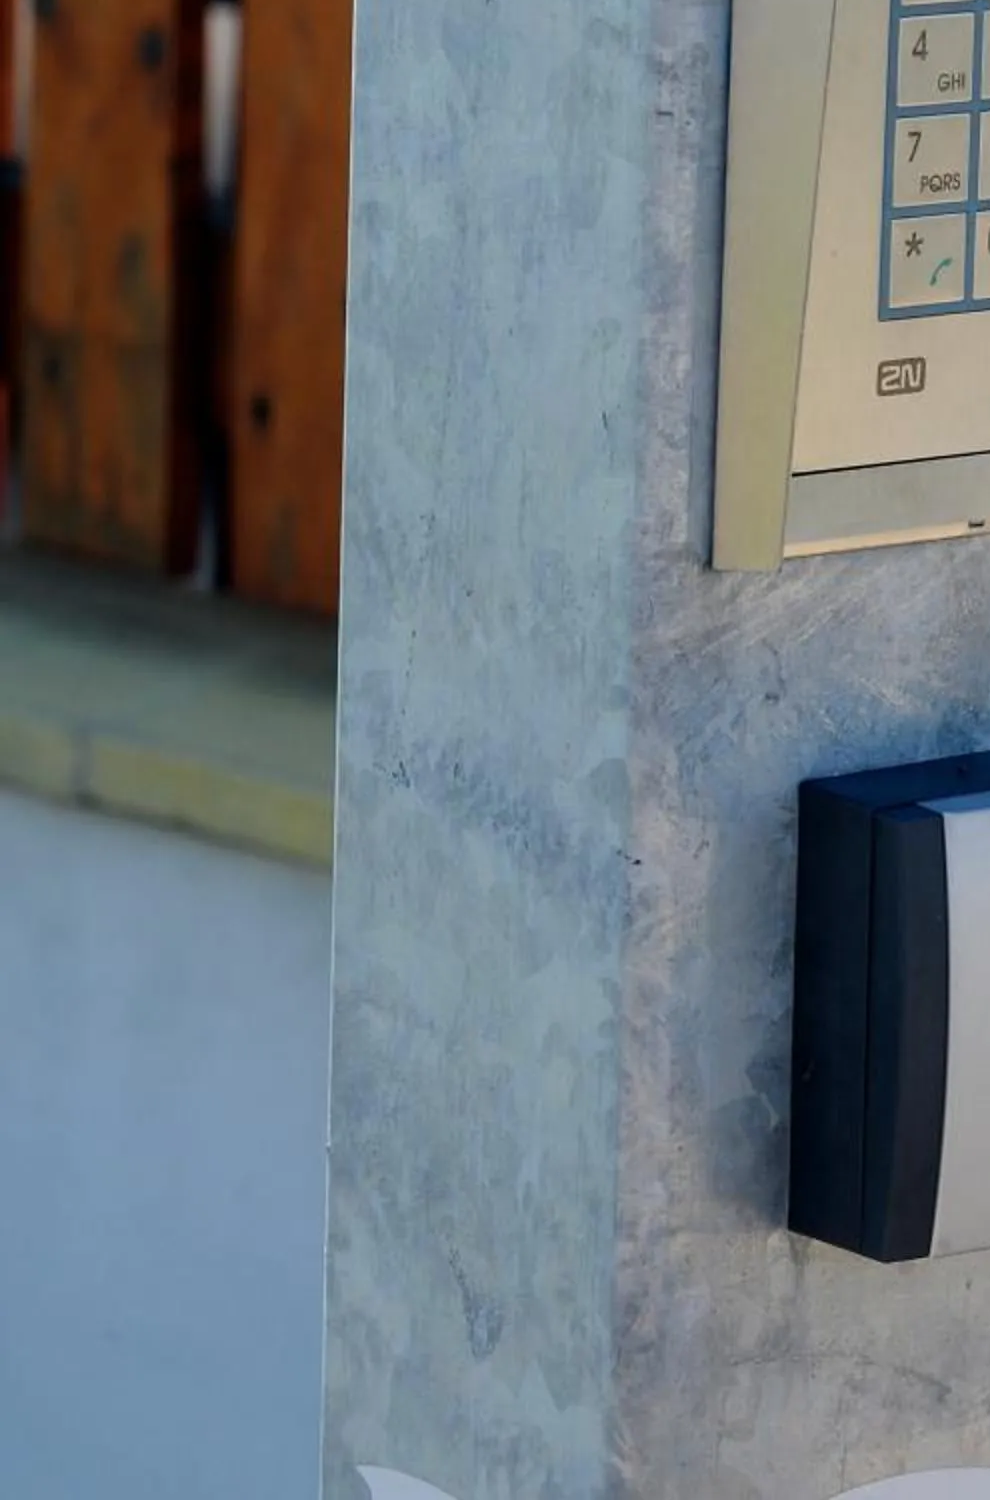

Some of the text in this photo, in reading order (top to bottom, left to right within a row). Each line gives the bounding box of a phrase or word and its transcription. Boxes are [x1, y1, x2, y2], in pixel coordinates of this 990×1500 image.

[911, 30, 929, 61] 4
[936, 73, 966, 92] GHI
[907, 131, 922, 162] 7
[919, 173, 961, 194] PQRS
